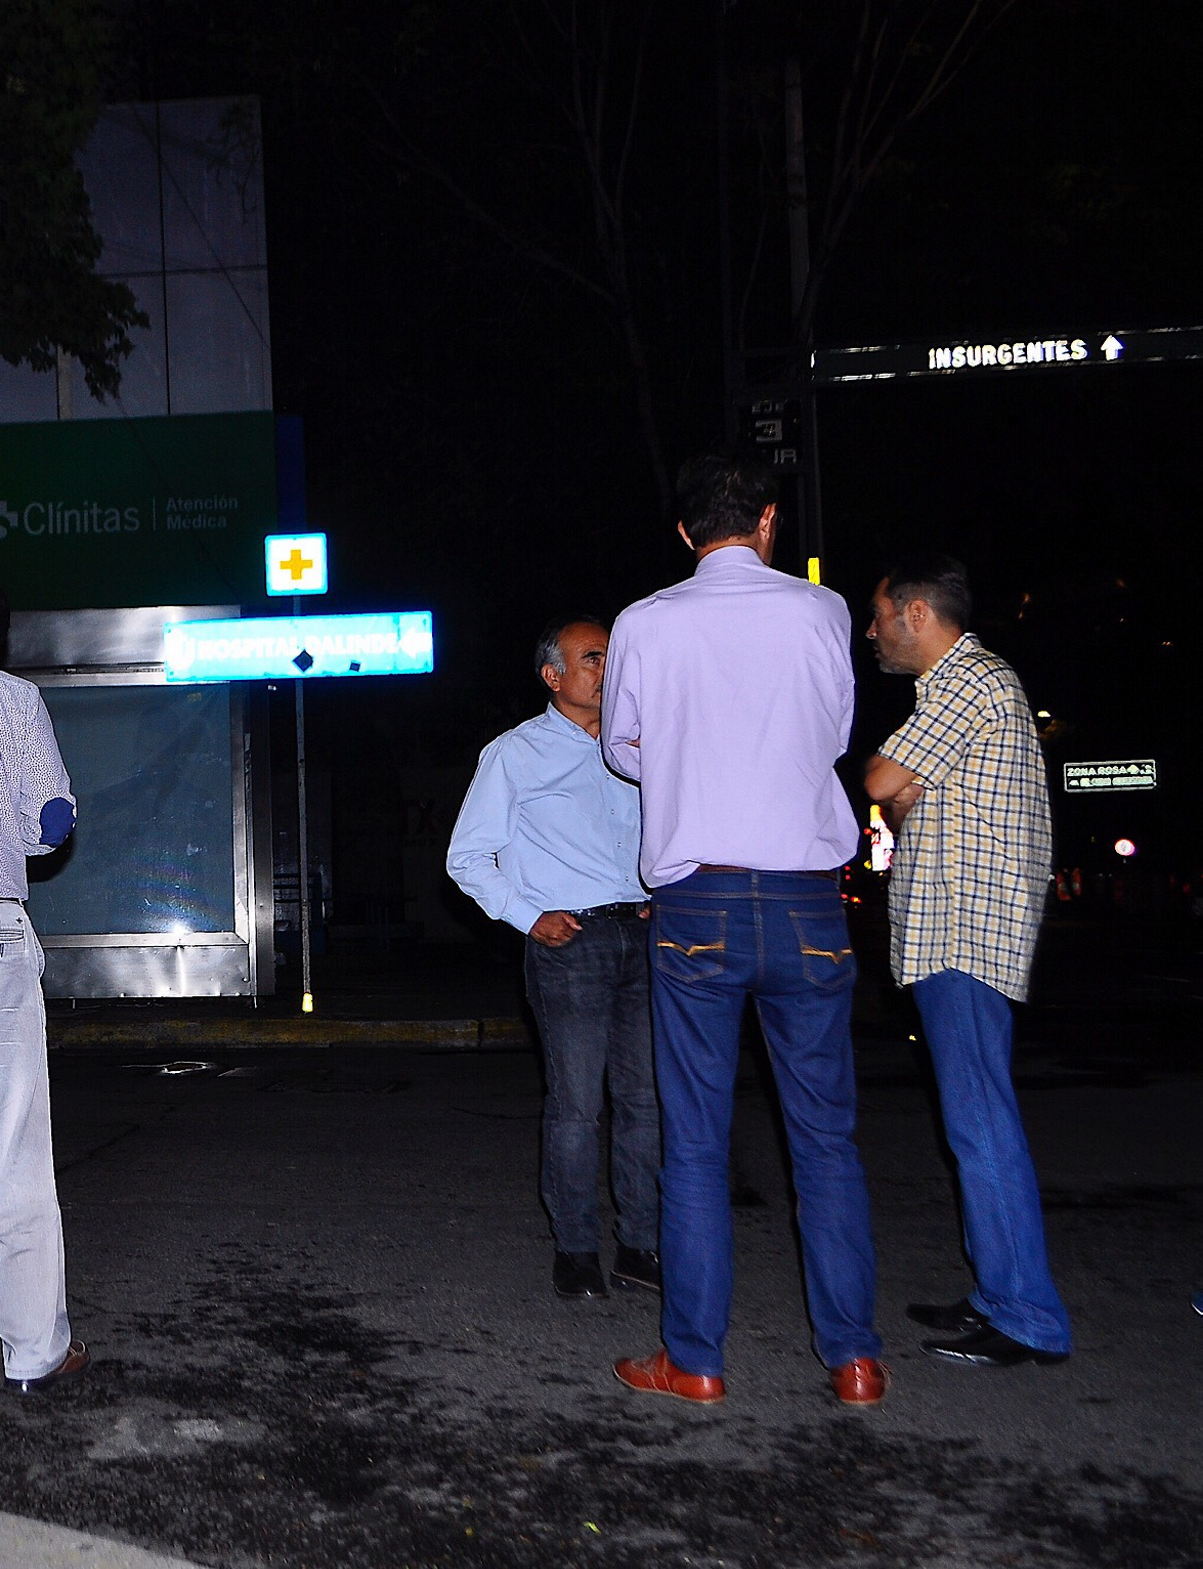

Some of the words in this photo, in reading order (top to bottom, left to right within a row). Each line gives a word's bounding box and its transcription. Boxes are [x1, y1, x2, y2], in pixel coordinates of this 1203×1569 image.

[928, 338, 1088, 370] INSURGENTES
[23, 499, 140, 536] Clínitas
[166, 493, 239, 512] Atención
[197, 635, 299, 661] HOSPITAL
[1067, 766, 1097, 777] ZONA
[1097, 765, 1128, 776] ROSA
